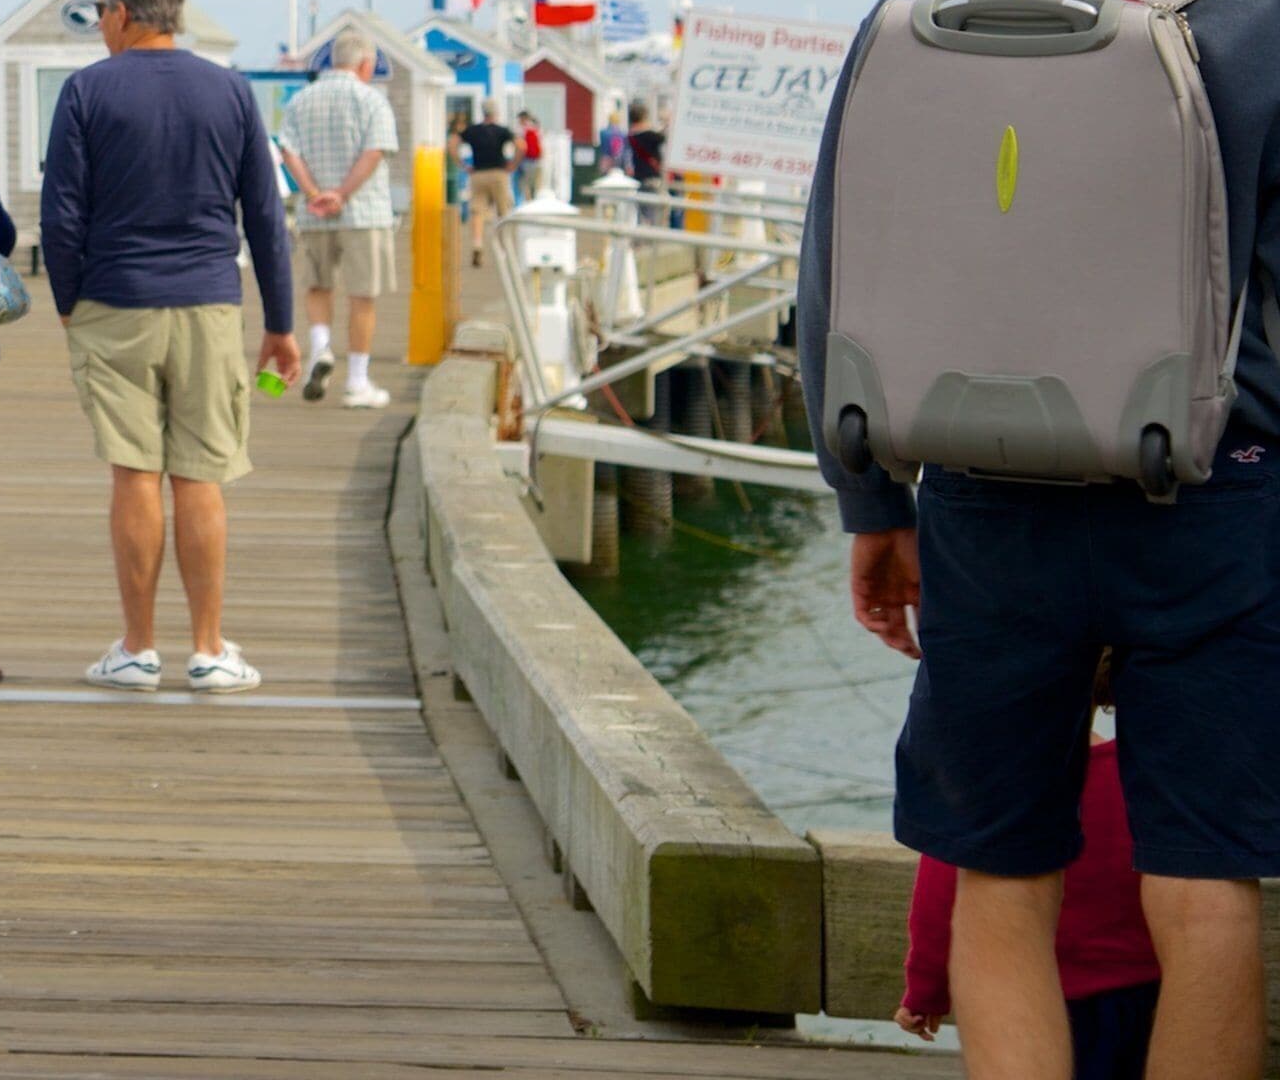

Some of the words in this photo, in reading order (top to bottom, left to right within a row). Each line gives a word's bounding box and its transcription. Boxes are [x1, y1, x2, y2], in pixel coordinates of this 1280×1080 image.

[693, 18, 766, 49] Fishing
[771, 26, 845, 58] Parties
[688, 63, 761, 92] CEE
[758, 63, 841, 99] JAY
